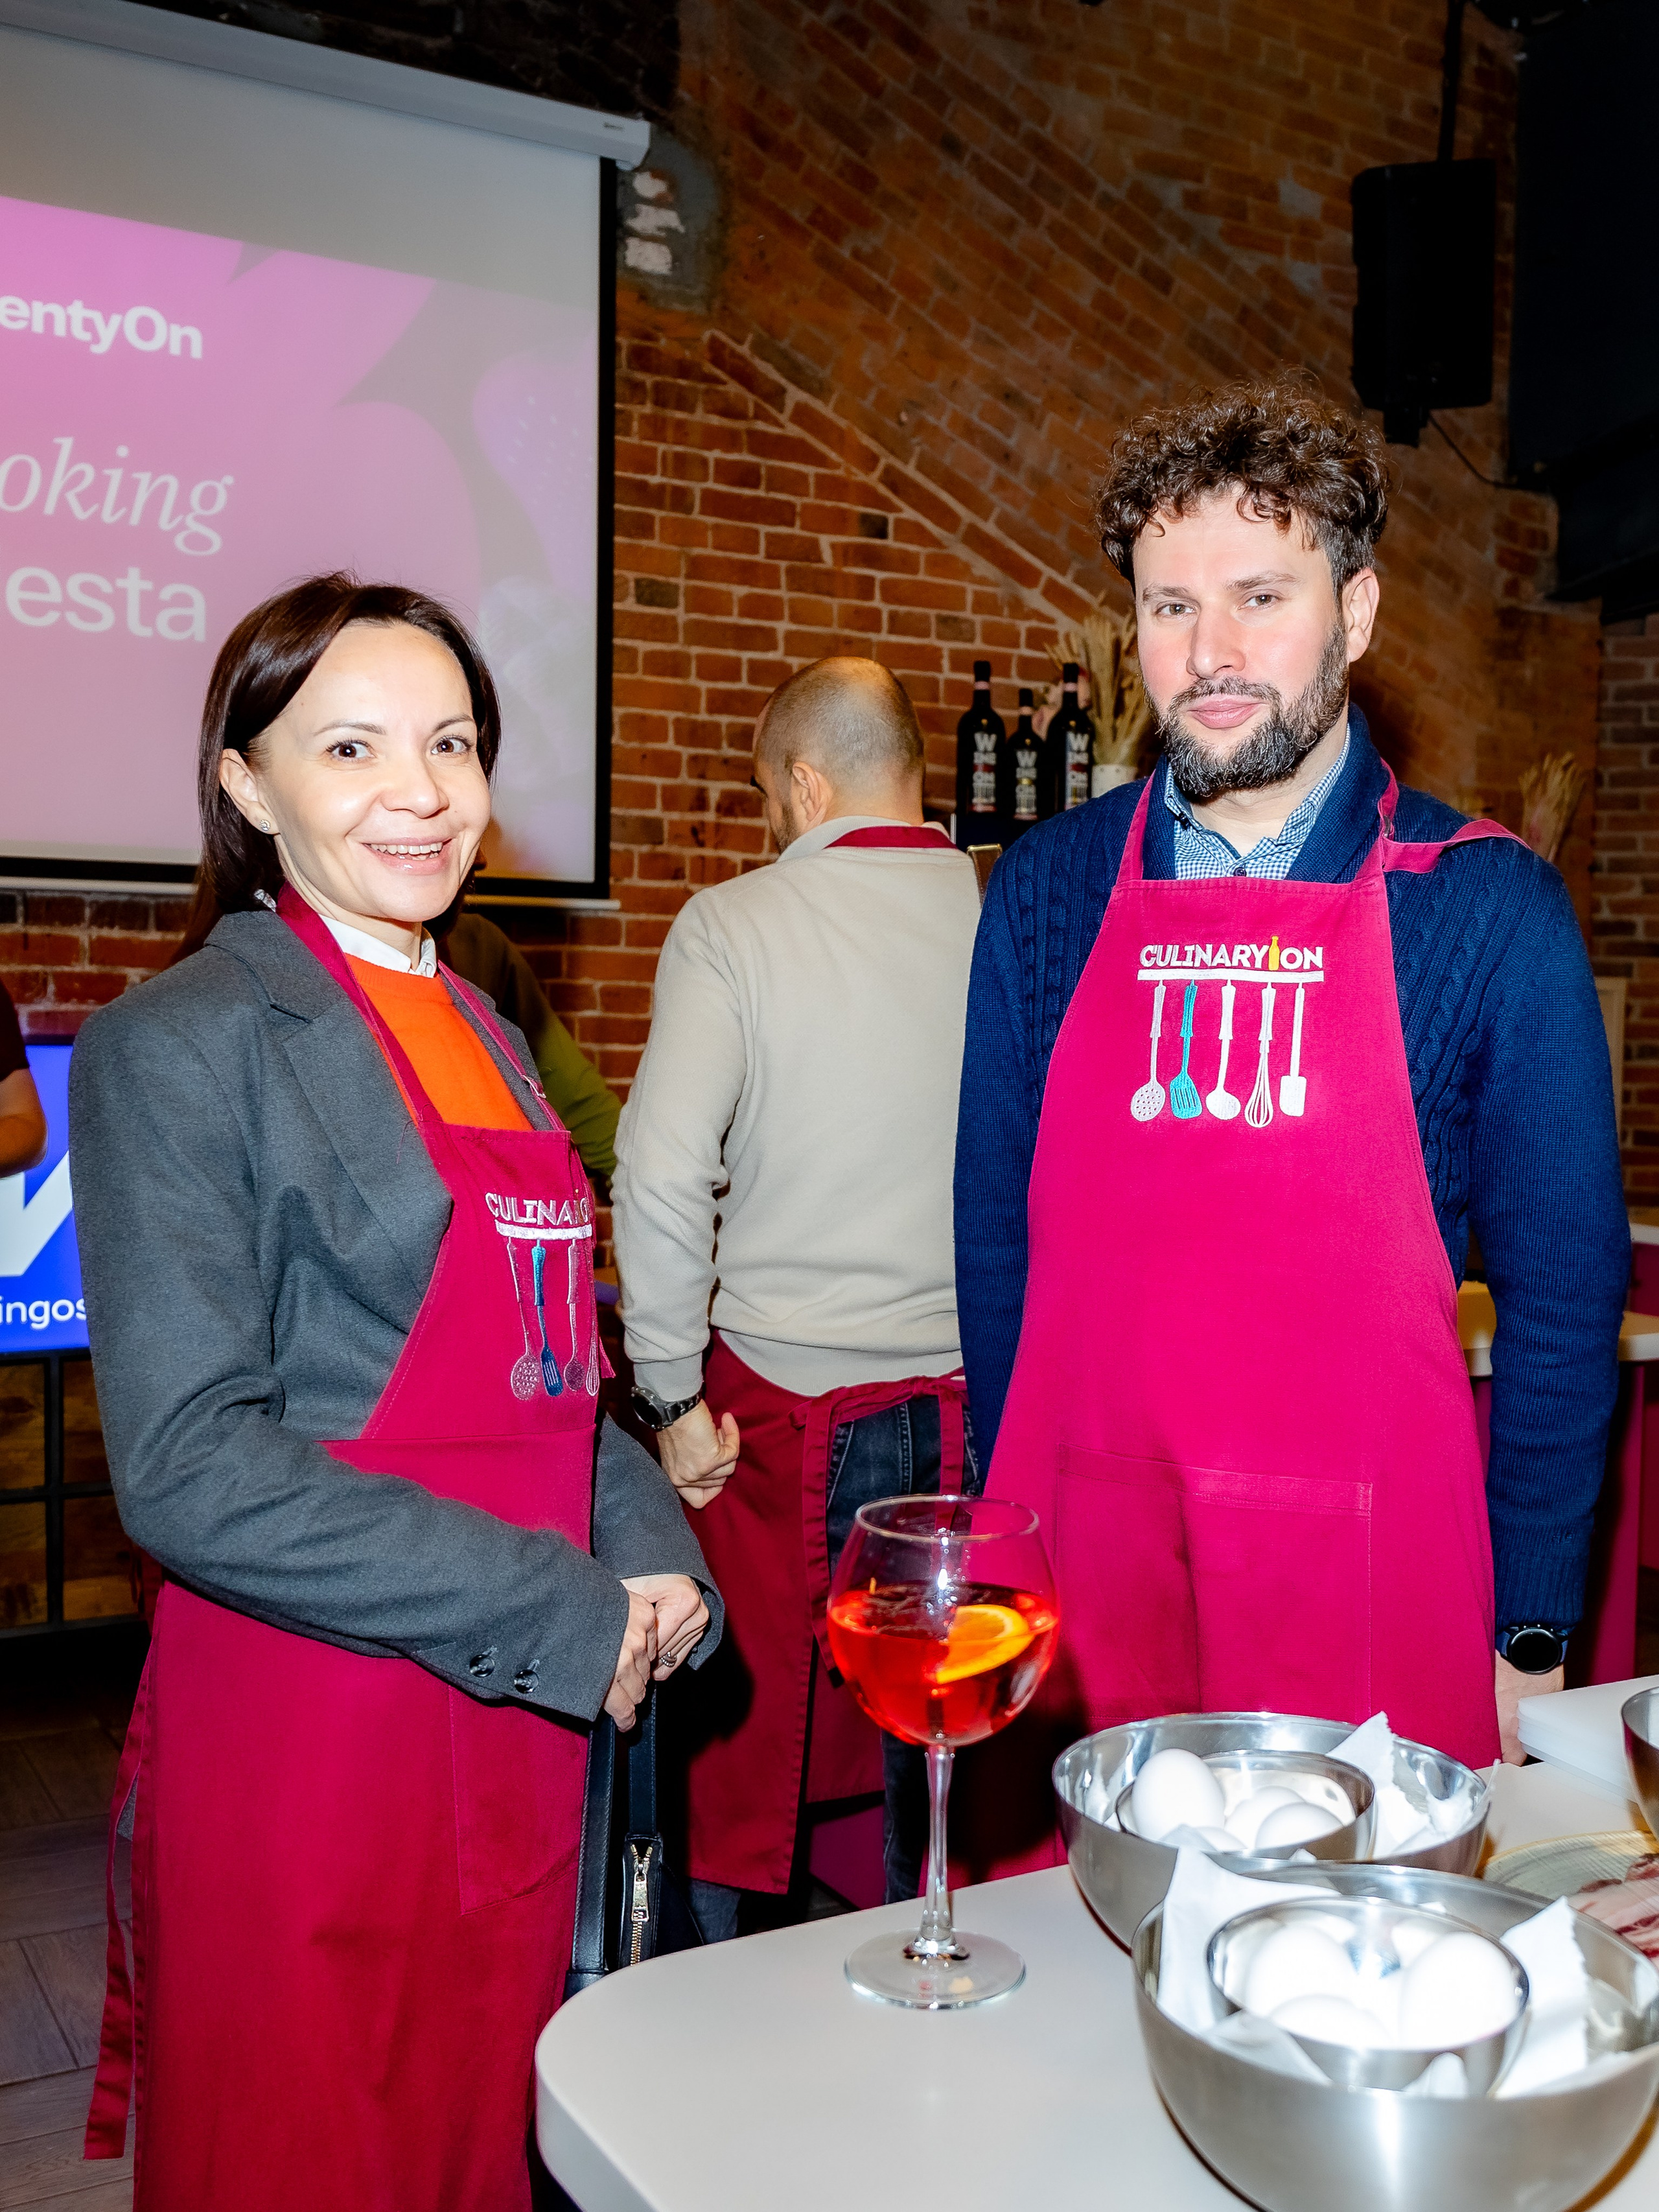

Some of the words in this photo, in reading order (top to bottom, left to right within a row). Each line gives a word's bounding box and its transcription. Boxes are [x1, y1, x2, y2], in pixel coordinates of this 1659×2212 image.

[0, 295, 203, 359] entyOn
[0, 436, 235, 555] oking
[5, 566, 206, 642] esta
[485, 1192, 578, 1226] CULINA
